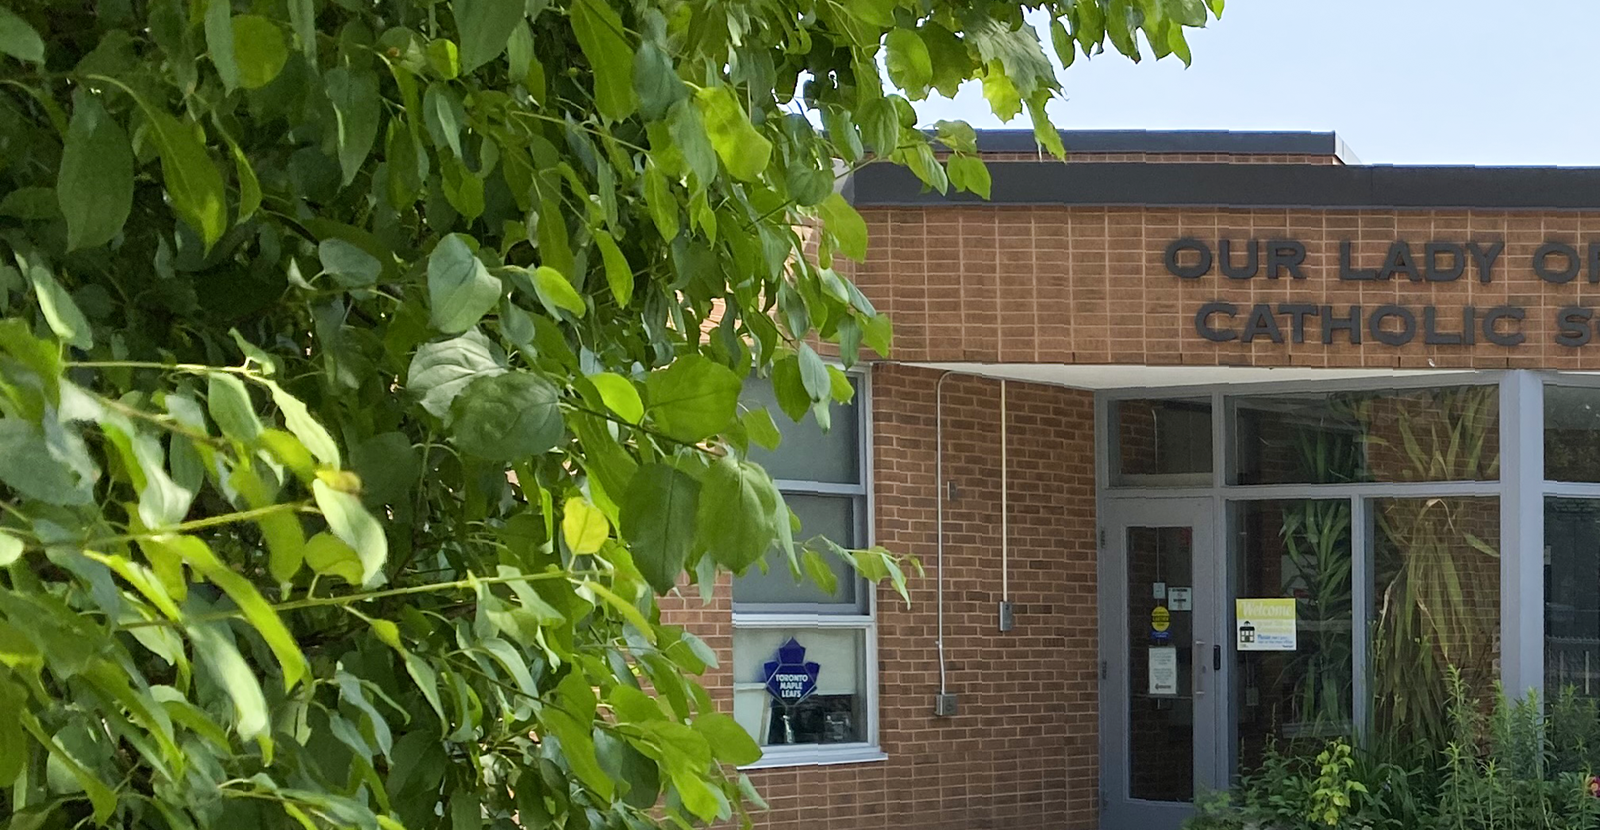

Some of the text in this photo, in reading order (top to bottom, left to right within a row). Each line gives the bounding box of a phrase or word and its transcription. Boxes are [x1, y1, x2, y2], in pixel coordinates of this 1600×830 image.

[1164, 237, 1307, 280] OUR
[1339, 239, 1506, 283] LADY
[1194, 302, 1527, 346] CATHOLIC
[1242, 601, 1294, 617] Welcome
[776, 674, 808, 682] TORONTO
